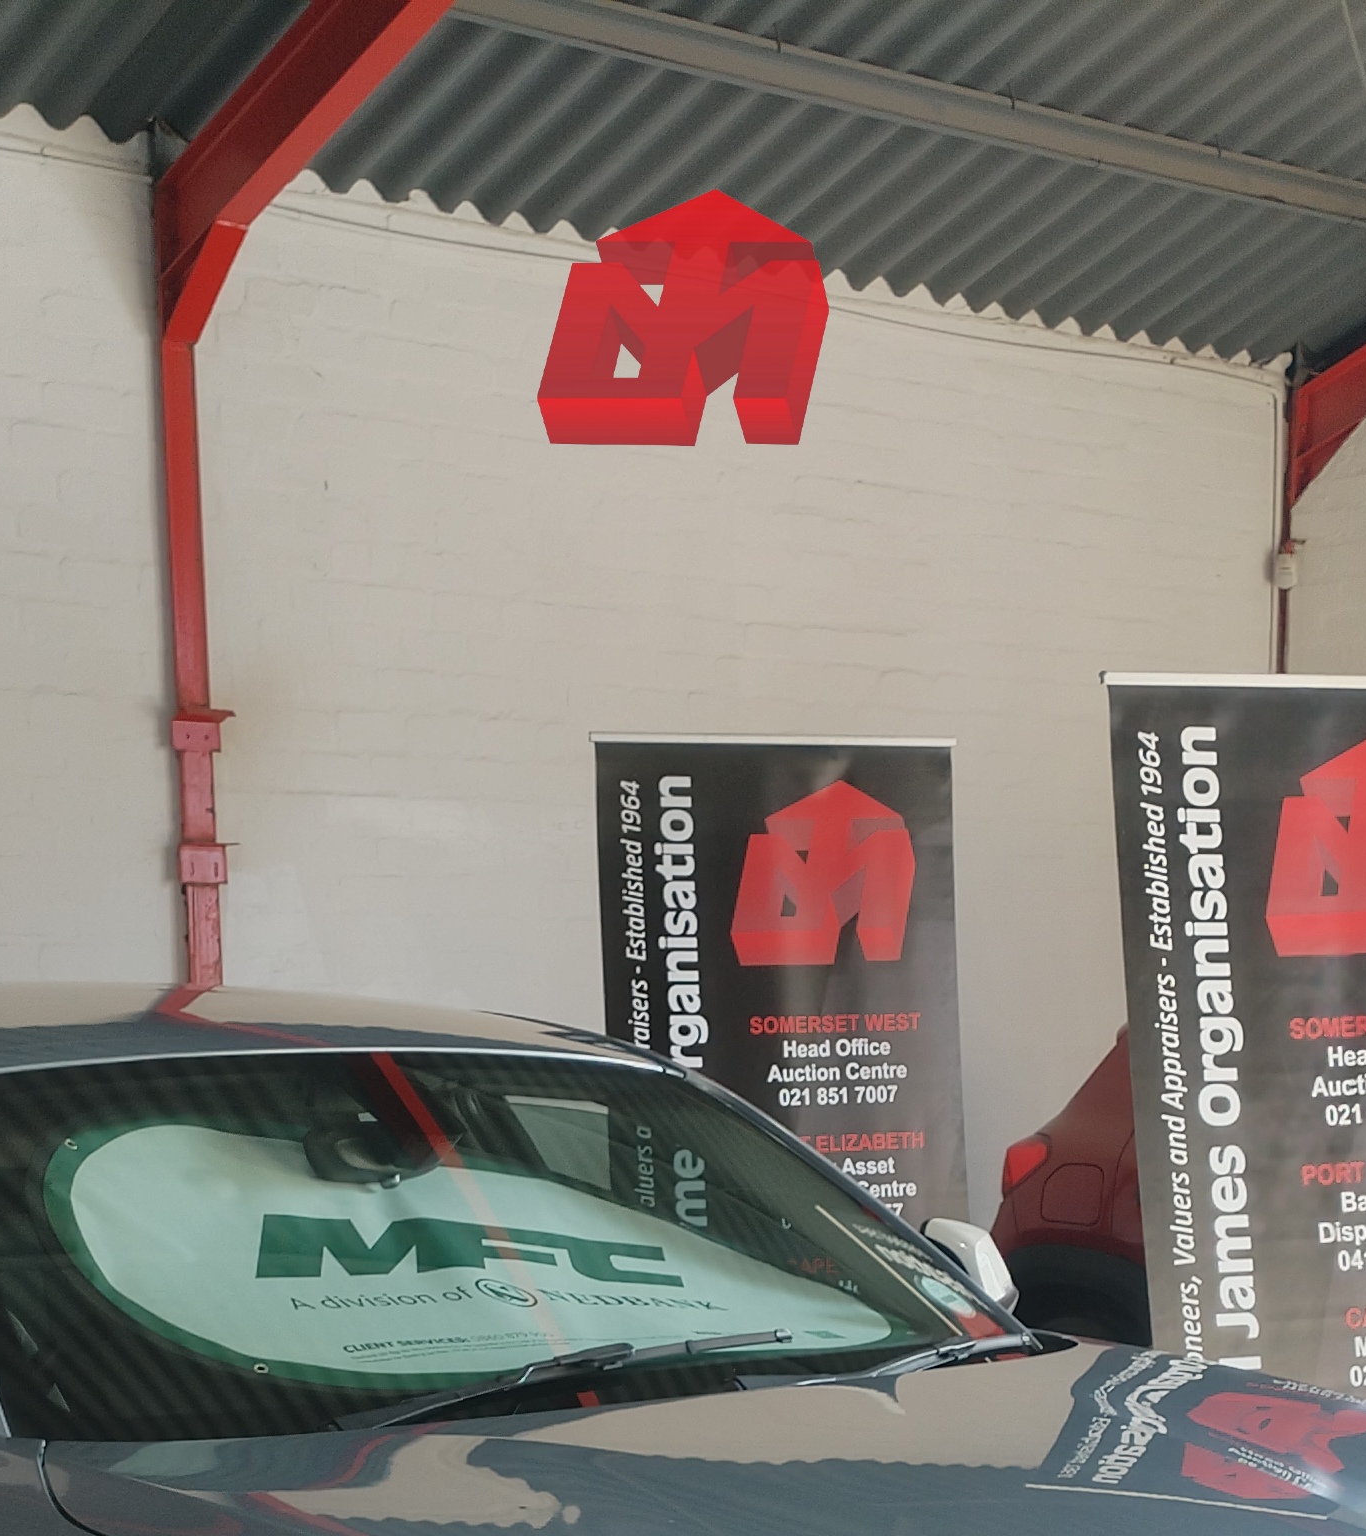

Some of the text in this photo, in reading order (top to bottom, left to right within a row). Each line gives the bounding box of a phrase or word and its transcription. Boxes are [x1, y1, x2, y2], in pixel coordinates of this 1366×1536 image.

[1137, 731, 1163, 795] 1964
[620, 780, 642, 833] 1964
[620, 838, 647, 962] Established
[1139, 801, 1174, 952] Established
[654, 775, 709, 1069] rganisation
[1177, 725, 1244, 1128] Organisation
[628, 979, 650, 1050] raisers
[749, 1012, 921, 1035] SOMERSET WEST
[1154, 972, 1188, 1110] Appraisers
[766, 1062, 908, 1083] Auction Centre
[783, 1037, 891, 1058] Head Office
[778, 1084, 899, 1107] 021 851 7007
[1325, 1103, 1363, 1127] 021
[815, 1130, 925, 1154] ELIZABETH
[841, 1156, 896, 1176] Asset
[1161, 1114, 1186, 1166] and
[634, 1145, 655, 1208] aluers
[1300, 1160, 1365, 1187] PORT
[1170, 1172, 1196, 1267] Valuers
[1209, 1144, 1260, 1340] James
[255, 1213, 684, 1288] MFC
[290, 1286, 729, 1311] A division of NEDBANK
[1180, 1275, 1203, 1364] oneers,
[342, 1340, 394, 1353] CLIENT
